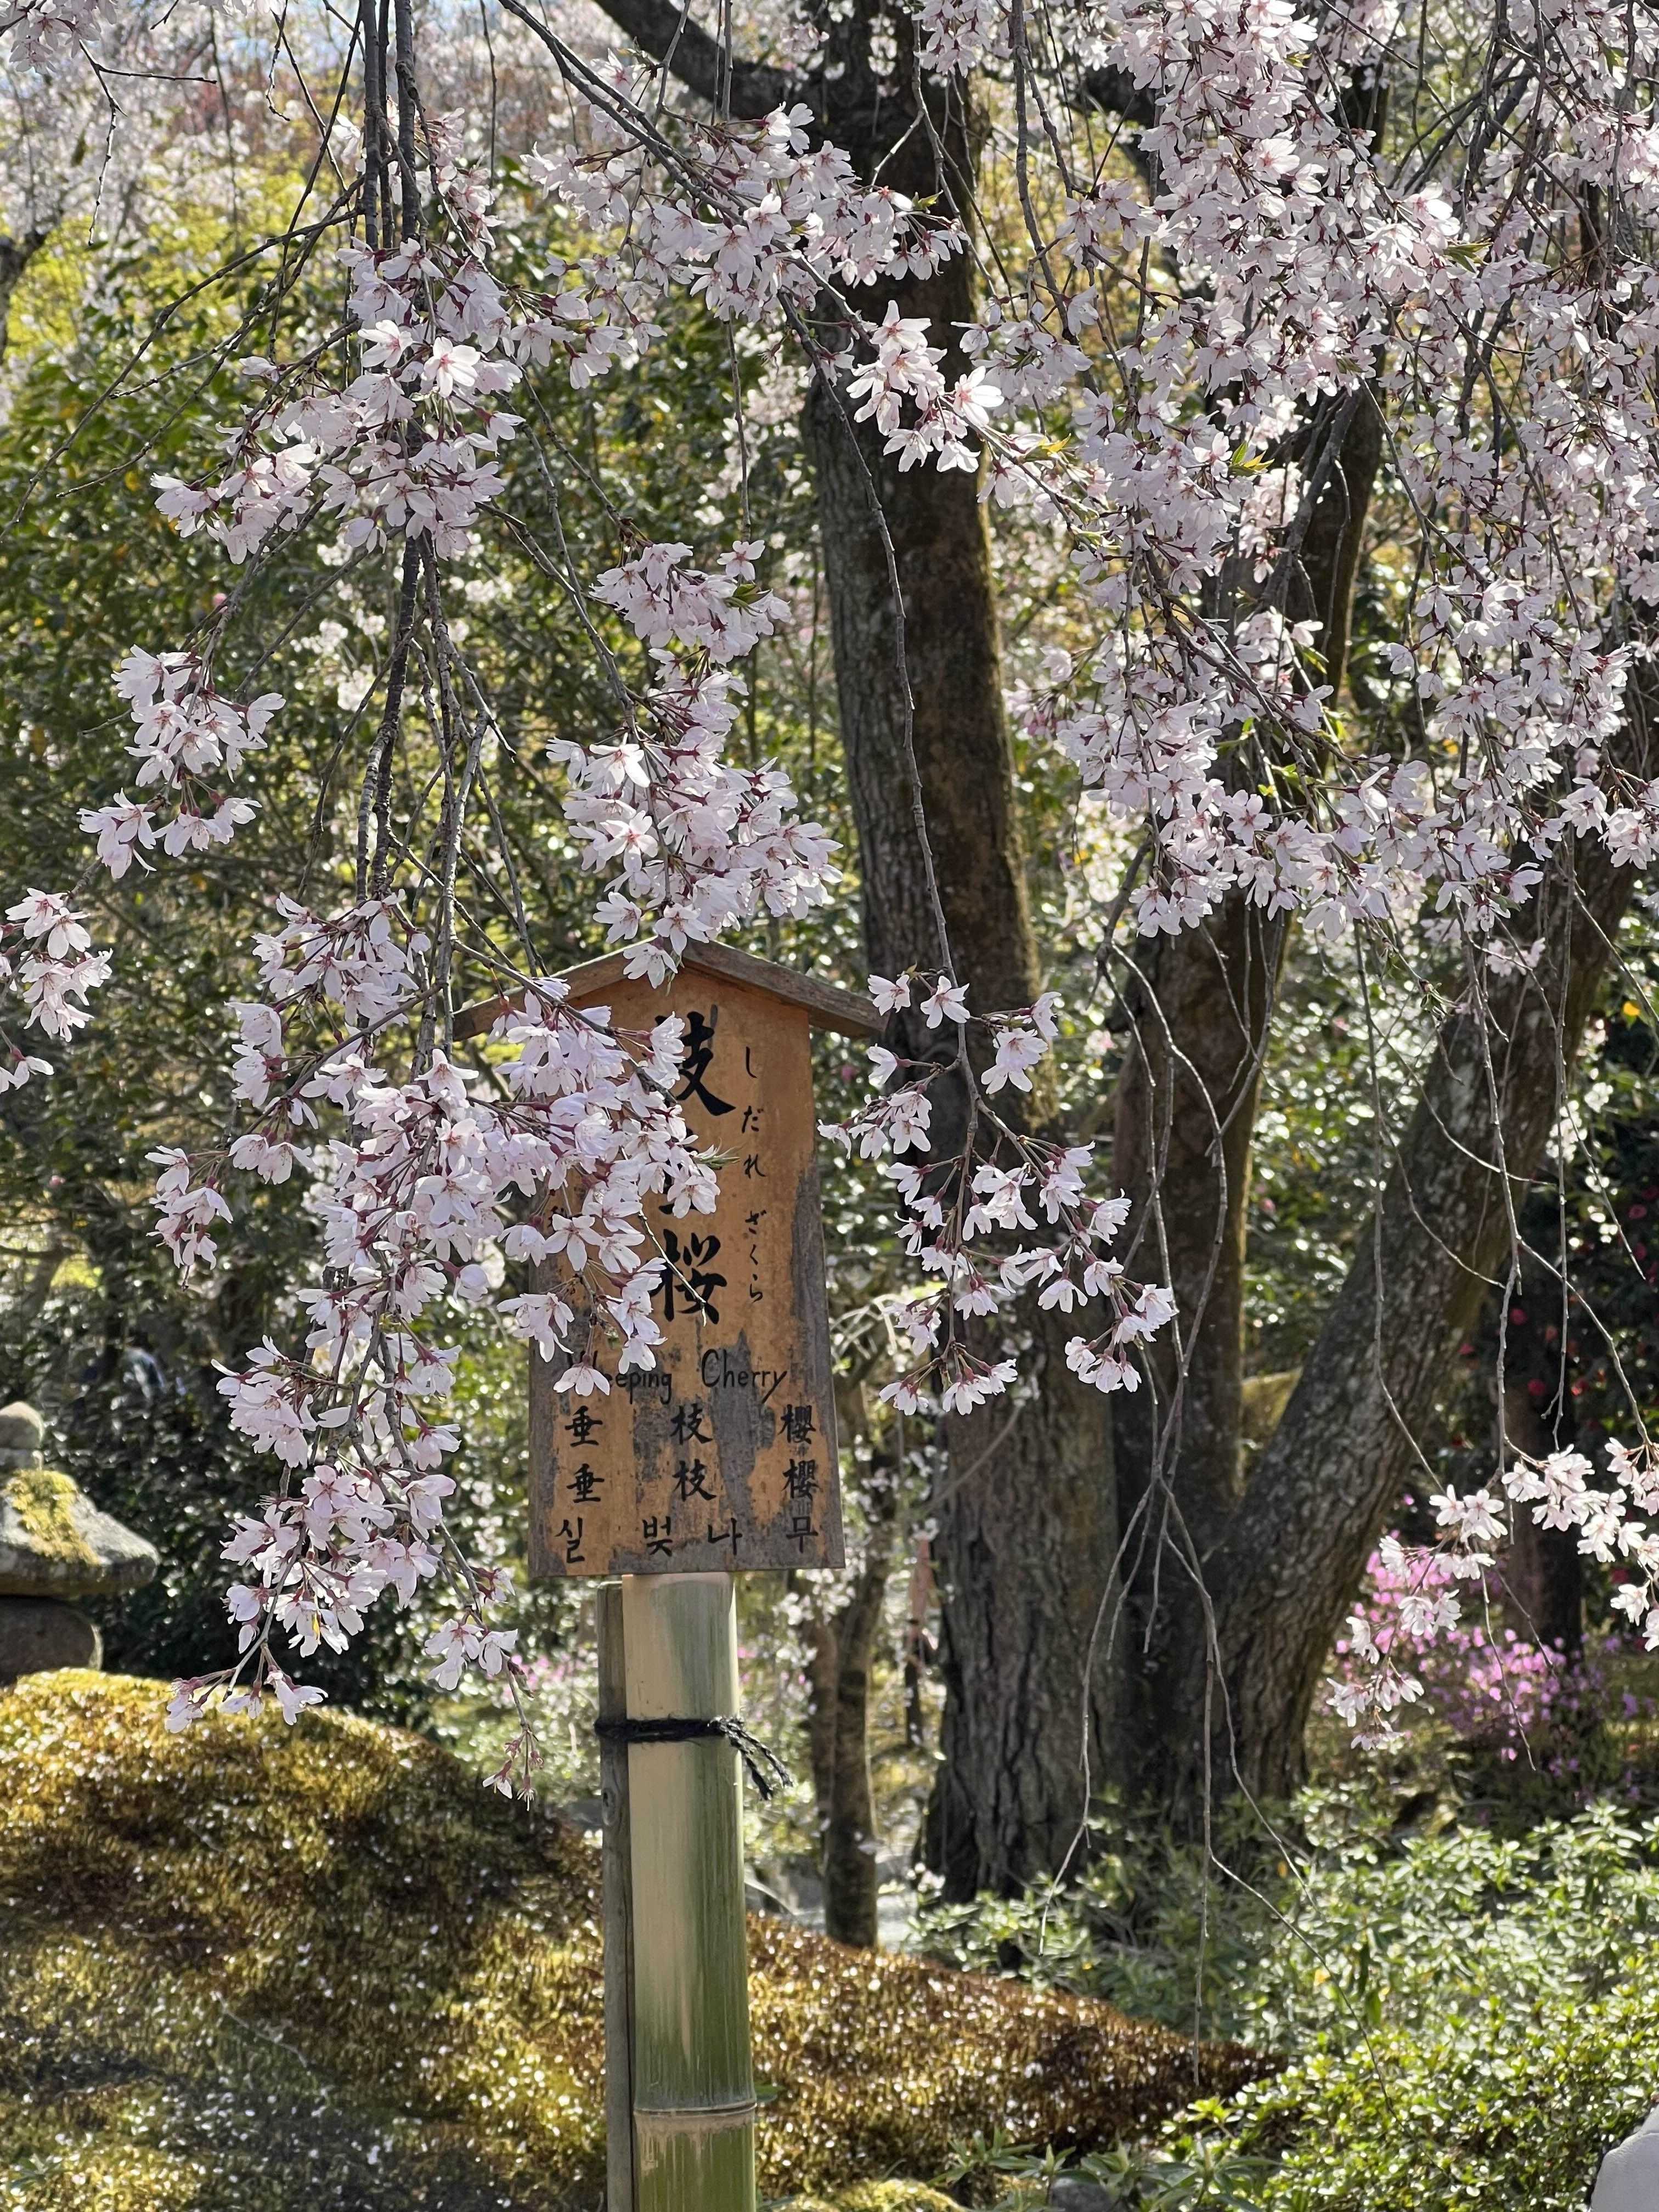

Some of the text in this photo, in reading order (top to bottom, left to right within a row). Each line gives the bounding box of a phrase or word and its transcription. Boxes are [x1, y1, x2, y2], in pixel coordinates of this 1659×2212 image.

[642, 1011, 736, 1324] 枝桜
[567, 1348, 787, 1405] eping Cherry
